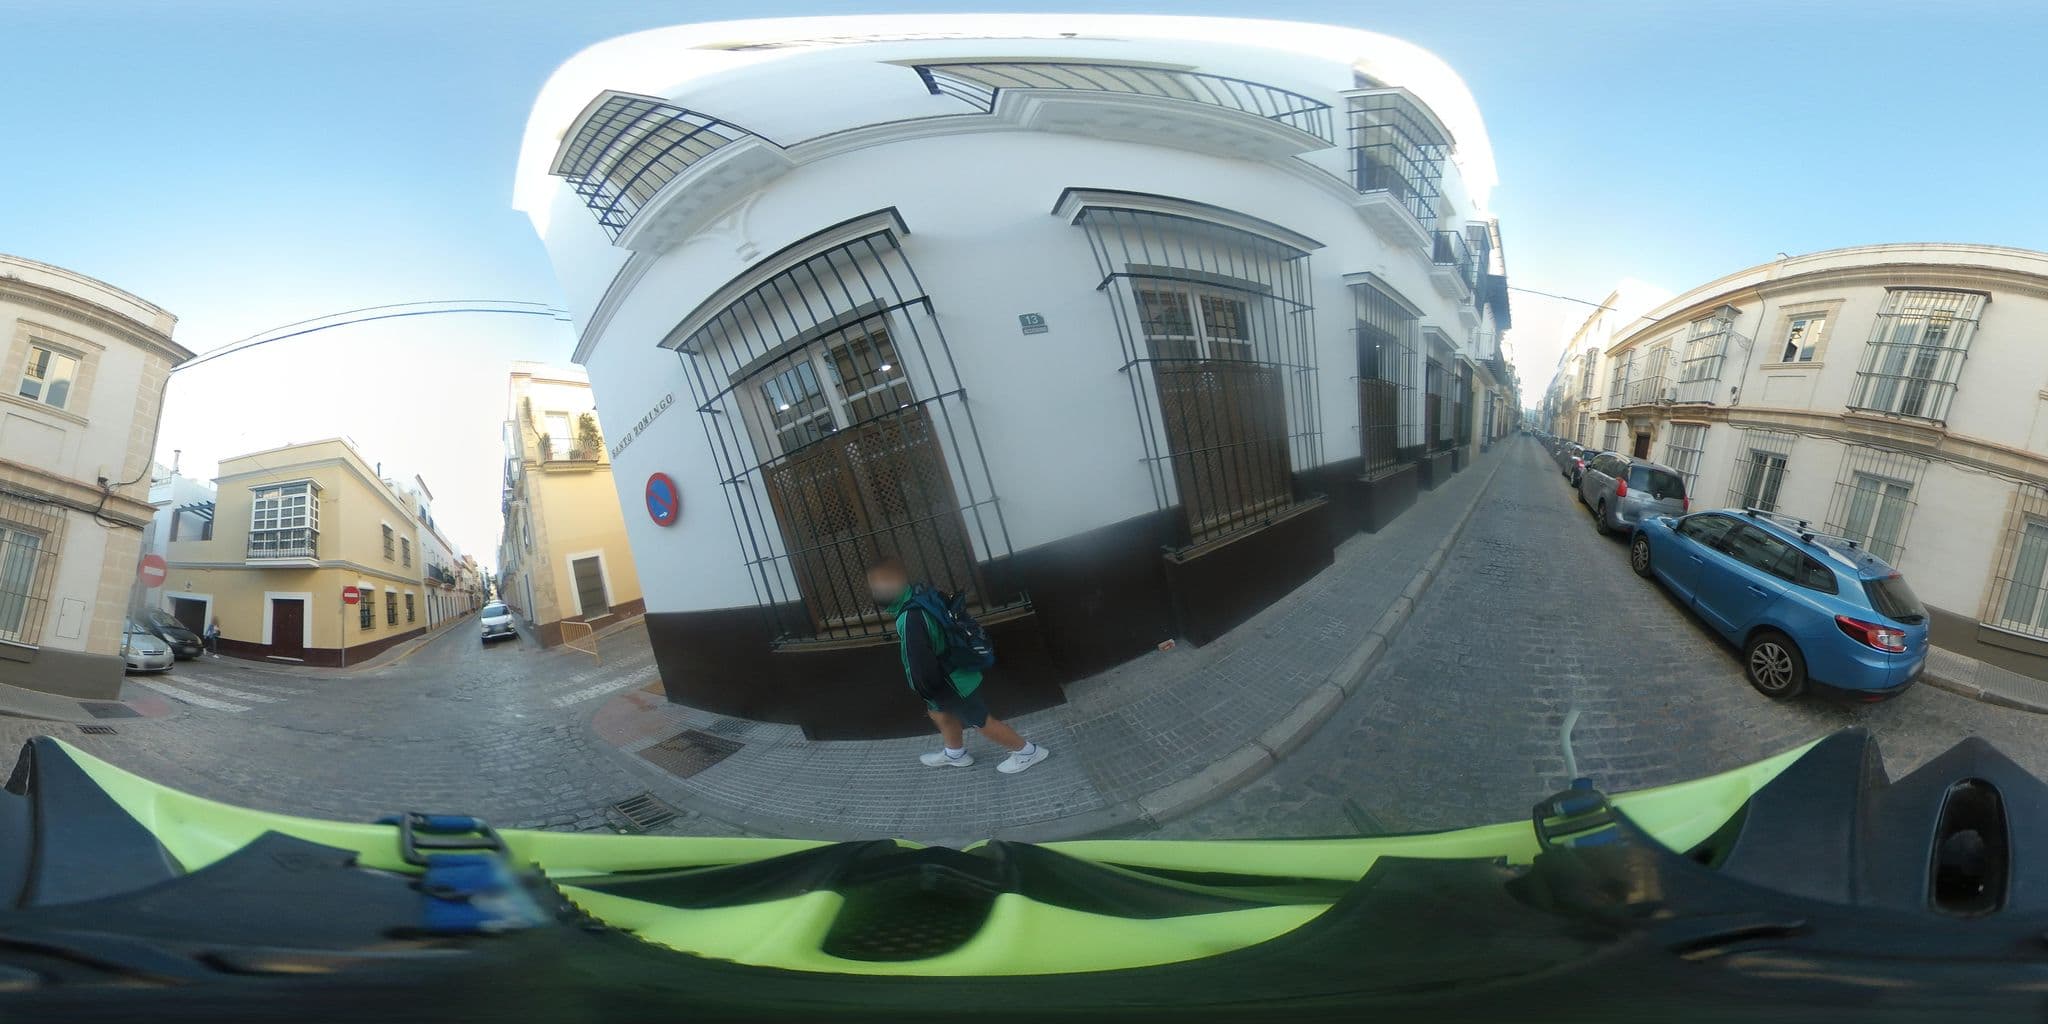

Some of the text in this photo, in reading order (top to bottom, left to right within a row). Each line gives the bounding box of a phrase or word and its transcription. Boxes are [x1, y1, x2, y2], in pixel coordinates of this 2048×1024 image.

[1026, 315, 1039, 325] 13
[611, 393, 673, 458] SANTO DOMINGO
